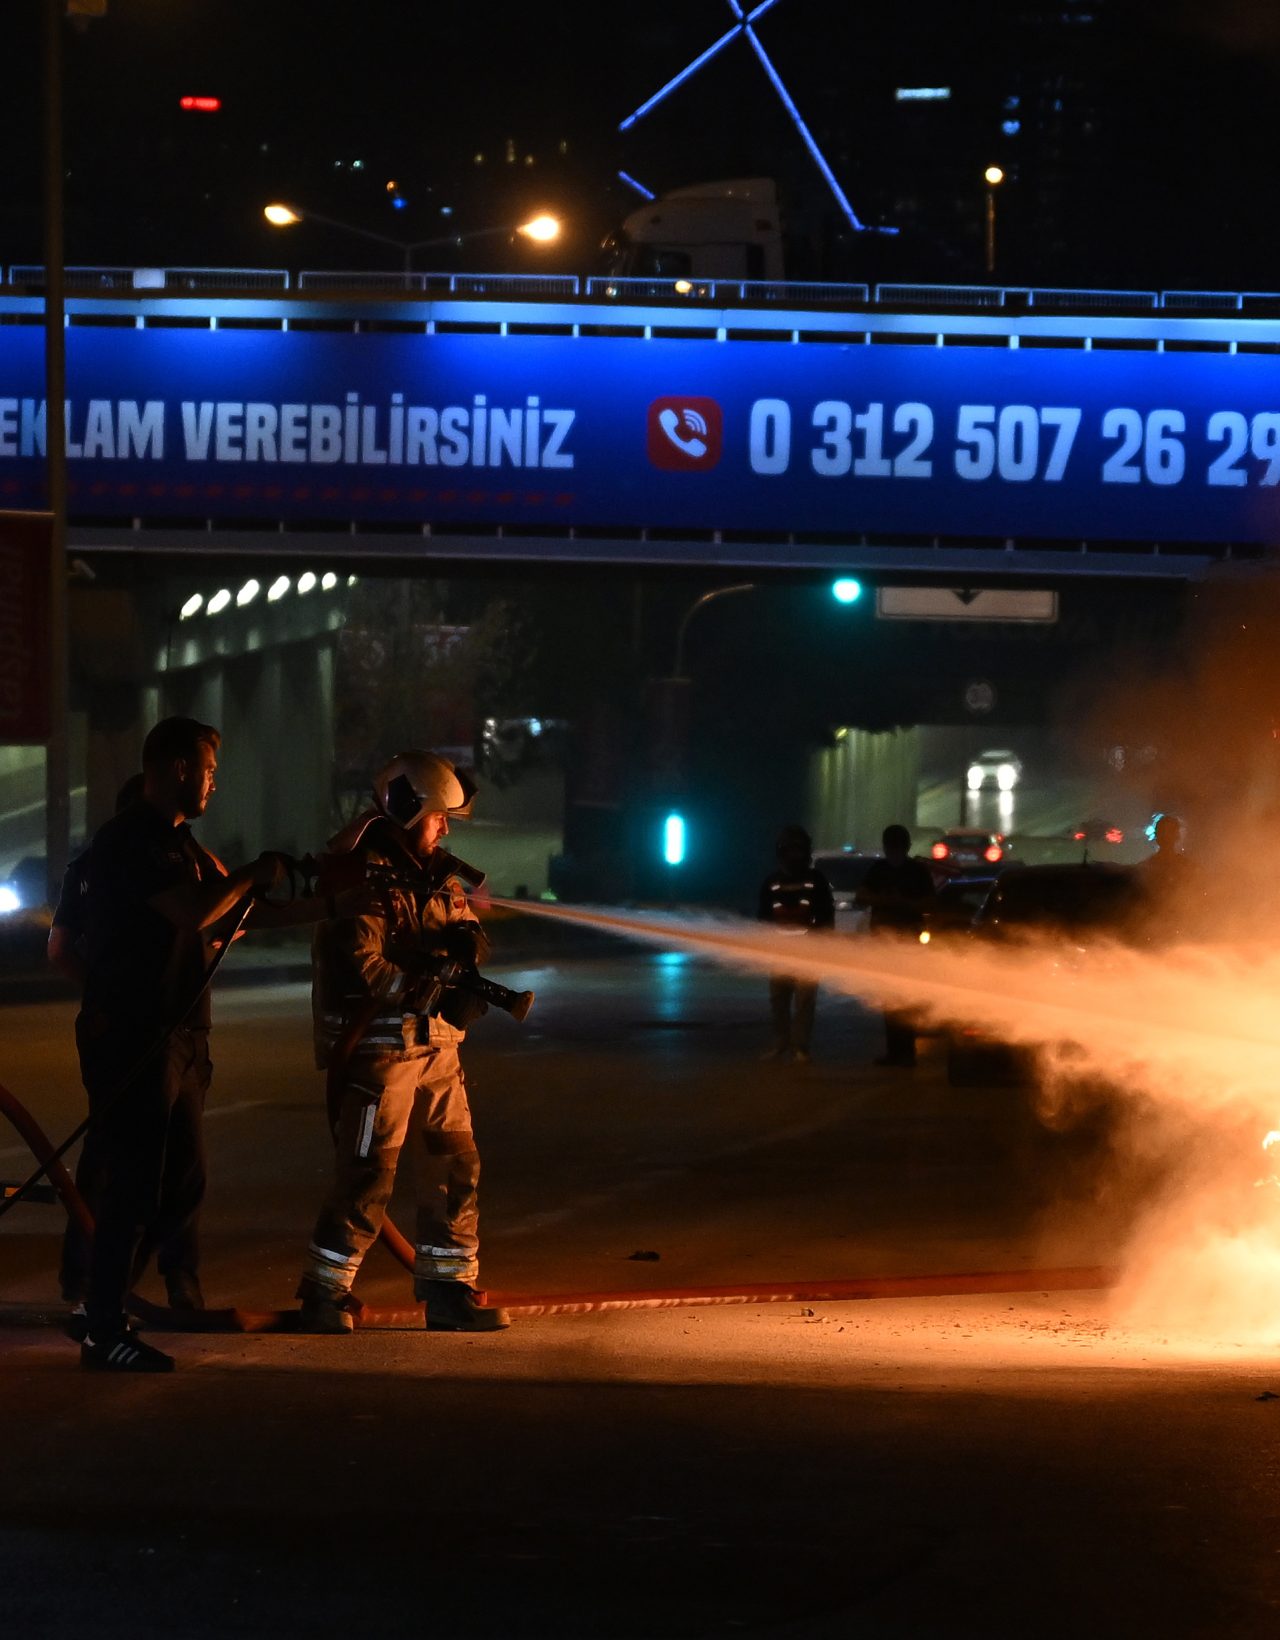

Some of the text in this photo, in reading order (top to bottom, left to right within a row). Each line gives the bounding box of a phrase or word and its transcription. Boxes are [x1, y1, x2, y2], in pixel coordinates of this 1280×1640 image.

[181, 392, 576, 468] VEREBİLİRSİNİZ
[749, 398, 791, 476] 0
[811, 400, 935, 478] 312
[954, 404, 1082, 482] 507
[1102, 407, 1186, 485] 26
